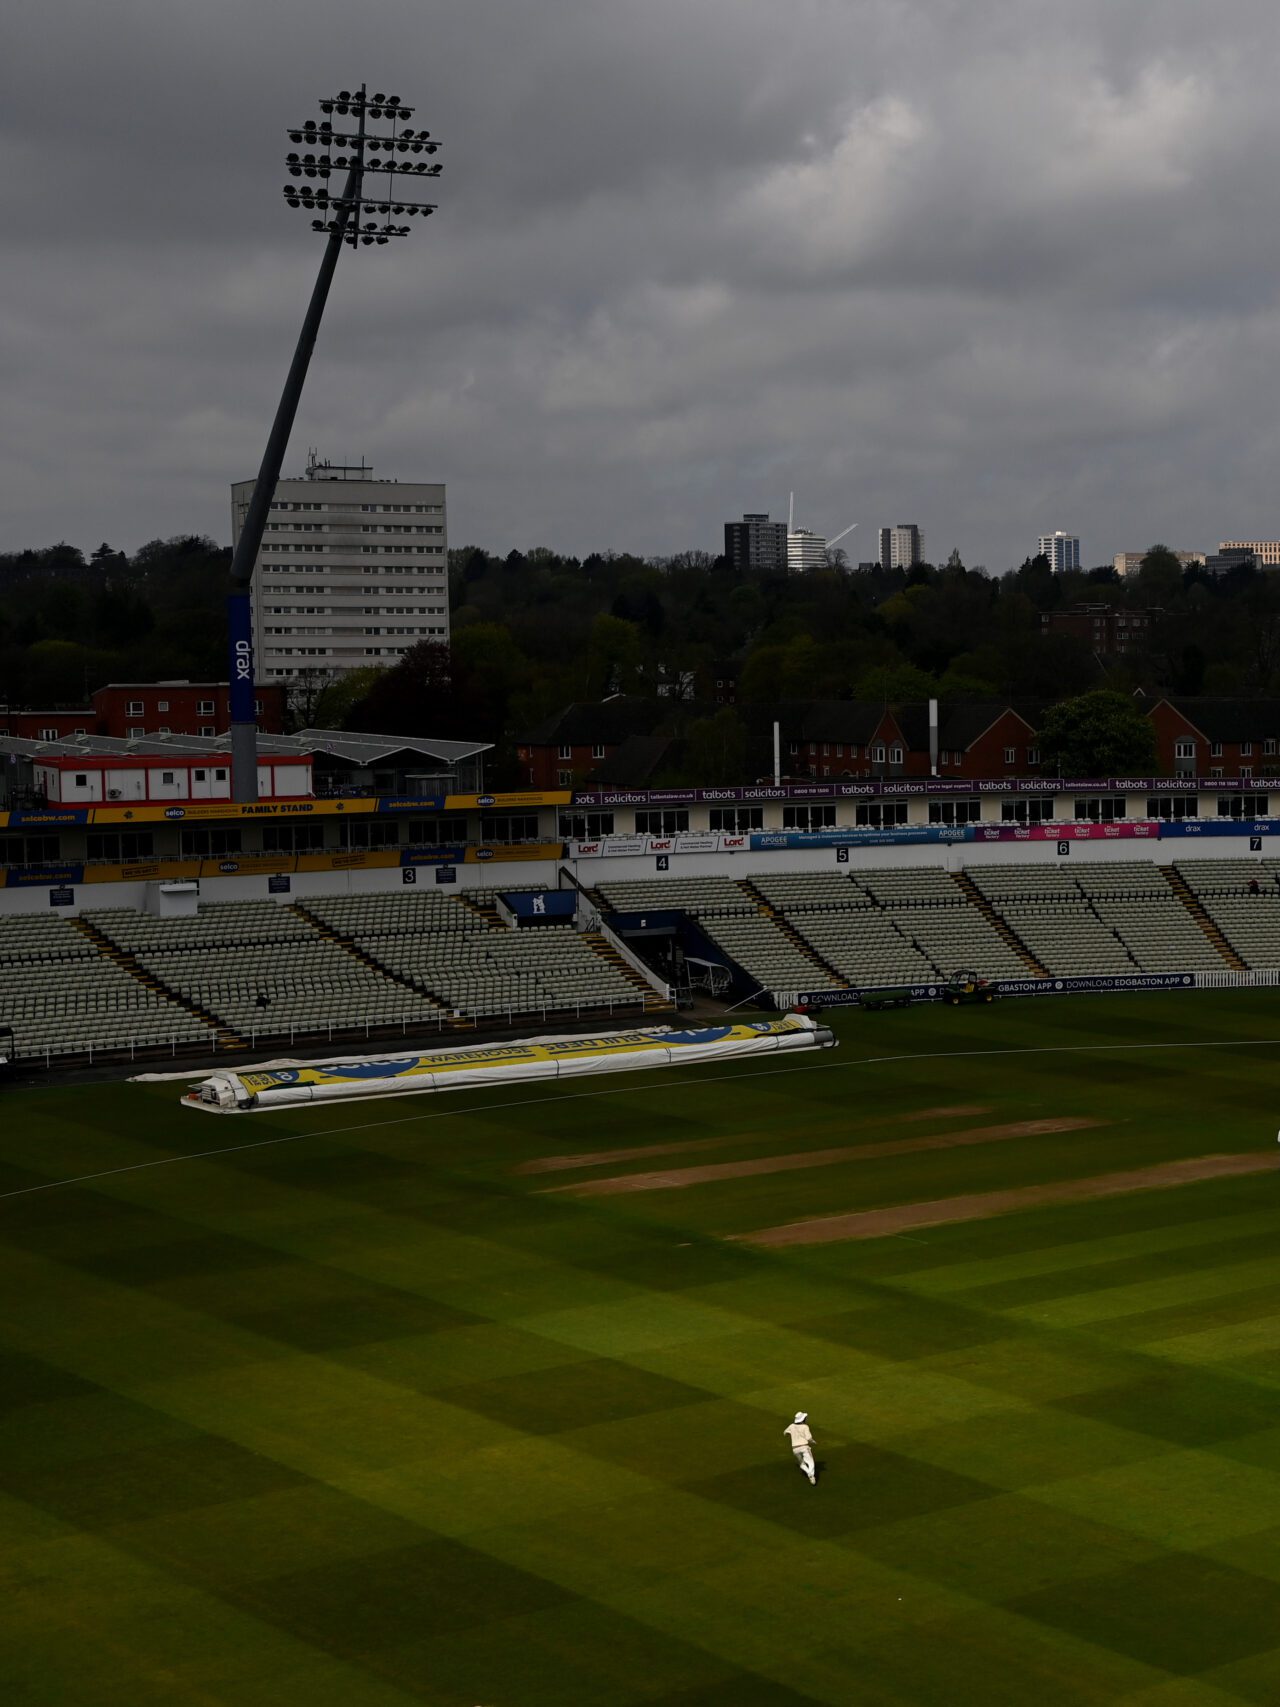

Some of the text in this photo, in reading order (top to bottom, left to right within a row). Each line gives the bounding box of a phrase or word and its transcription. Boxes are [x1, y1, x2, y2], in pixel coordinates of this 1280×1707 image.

[235, 640, 251, 680] drax
[884, 783, 925, 794] solicitors
[979, 782, 1011, 791] talbots
[1020, 782, 1061, 791] solicitors
[1115, 780, 1147, 789] talbots
[1156, 778, 1197, 789] solicitors
[702, 789, 736, 800] talbots
[744, 789, 786, 799] solicitors
[842, 785, 874, 795] talbots
[604, 793, 646, 804] solicitors
[166, 809, 184, 817] selco
[242, 803, 313, 814] FAMILY STAND
[21, 814, 76, 822] selcobw.com
[1186, 824, 1201, 832] drax
[1254, 823, 1269, 831] drax
[939, 830, 966, 838] APOGEE
[761, 836, 787, 844] APOGEE
[1252, 838, 1259, 849] 7
[1060, 843, 1067, 854] 6
[838, 850, 846, 860] 5
[658, 857, 667, 868] 4
[406, 870, 414, 882] 3
[1038, 982, 1053, 990] APP
[1066, 976, 1180, 990] DOWNLOAD EDGBASTON APP
